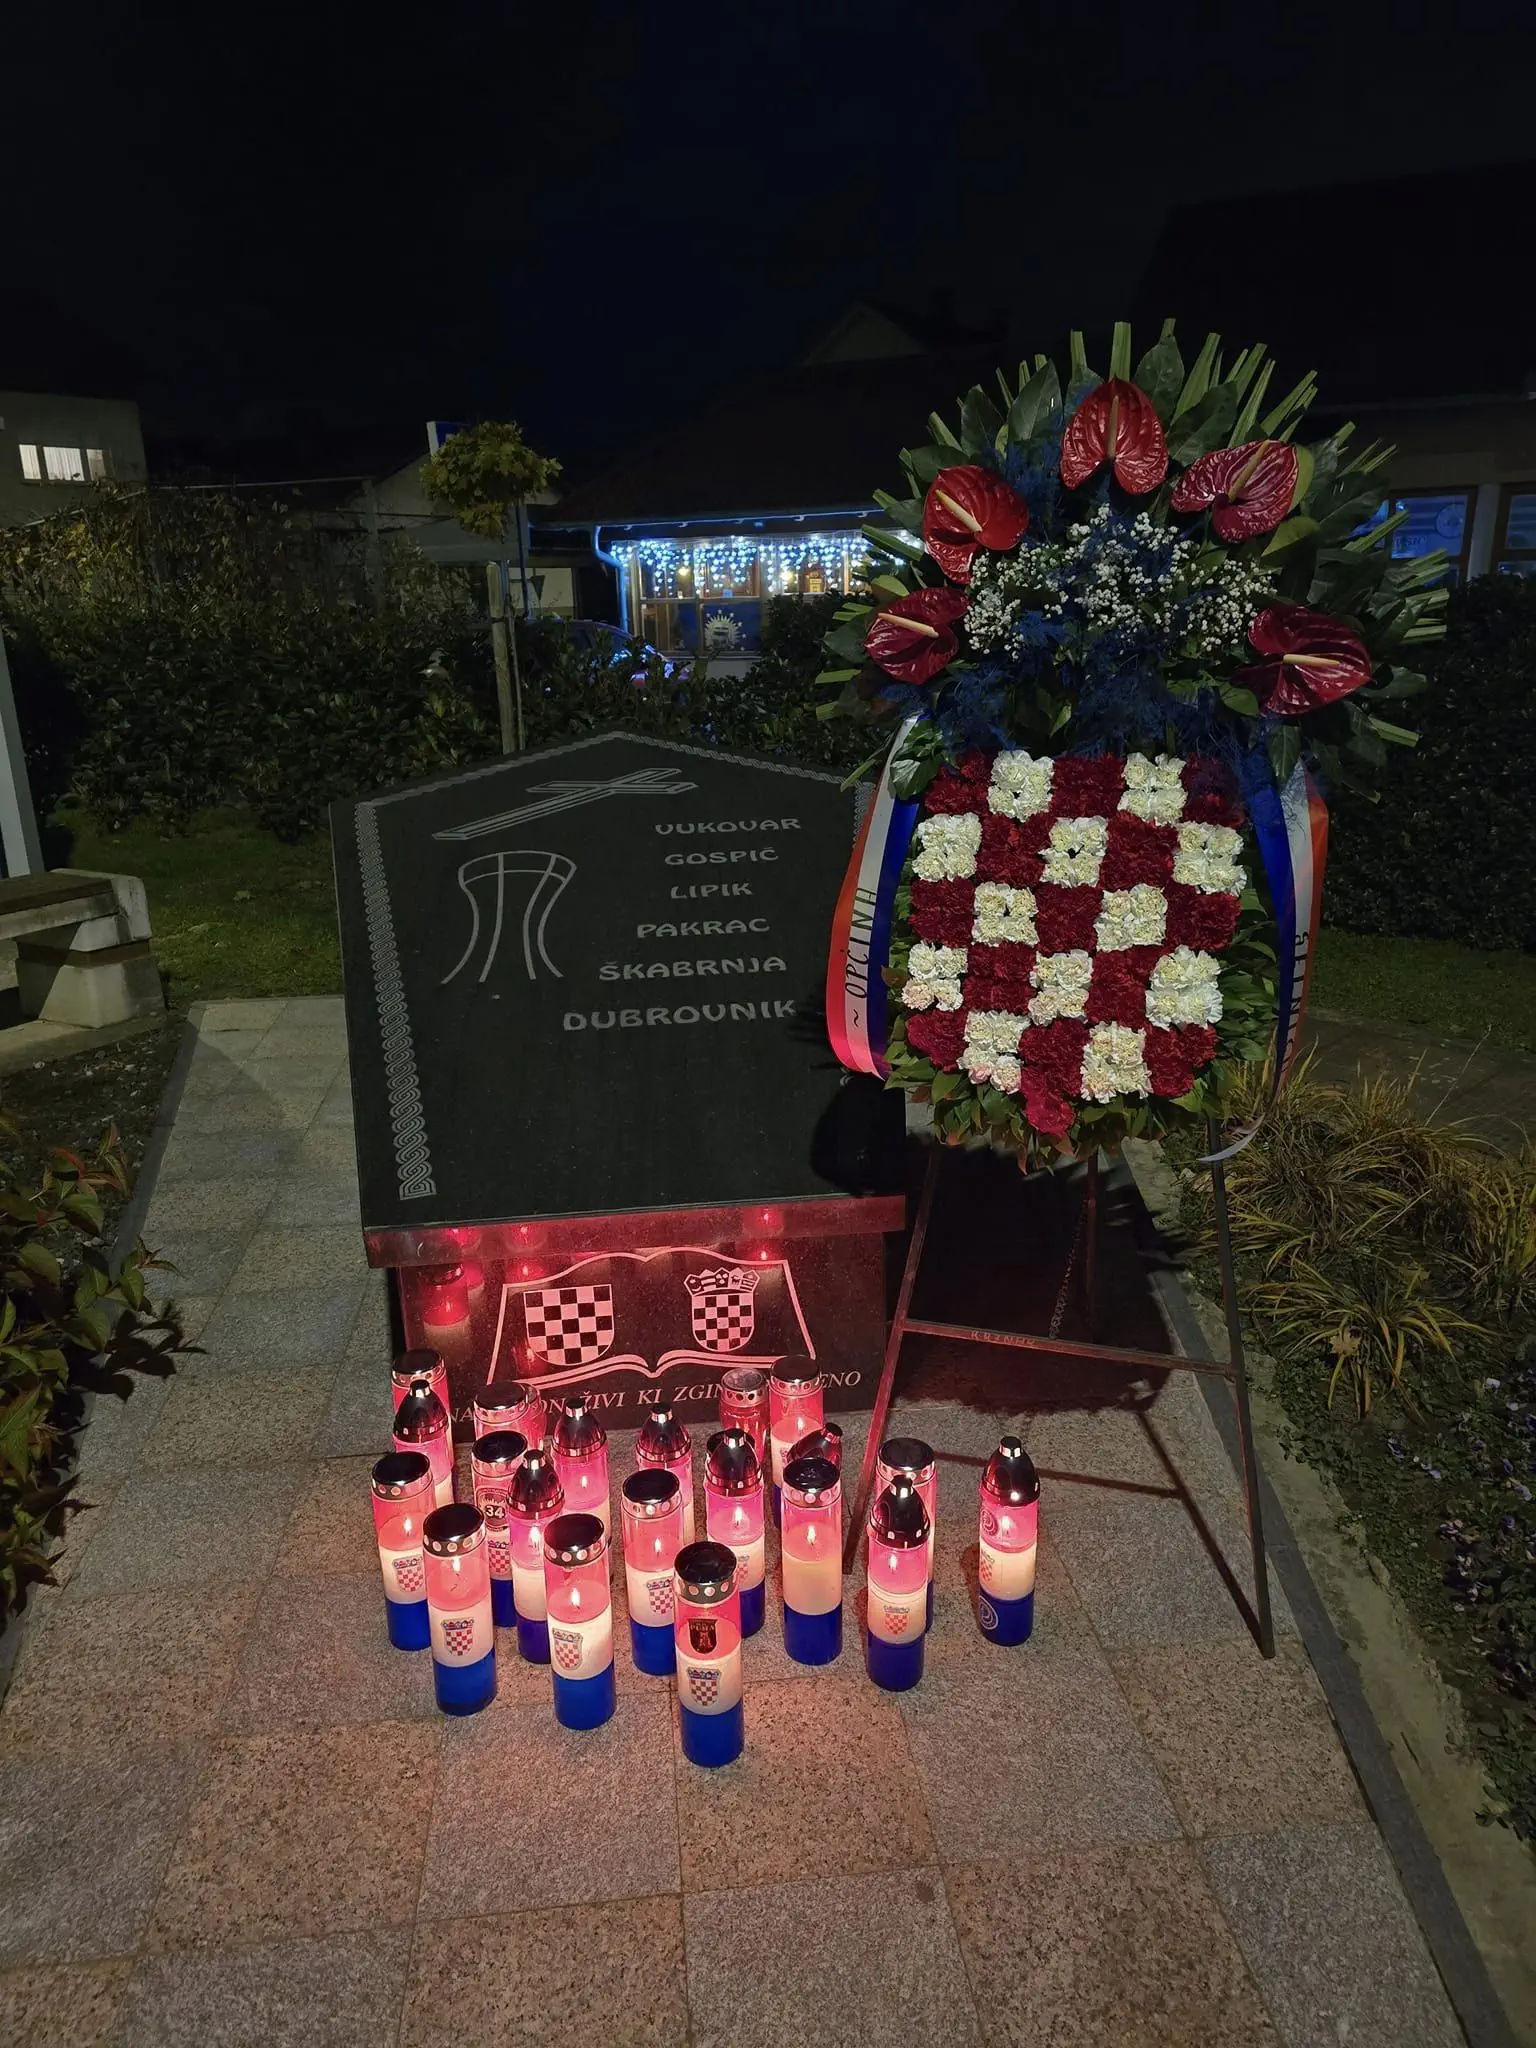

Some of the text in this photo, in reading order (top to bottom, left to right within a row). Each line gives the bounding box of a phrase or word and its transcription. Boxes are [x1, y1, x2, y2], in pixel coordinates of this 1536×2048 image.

[655, 818, 801, 835] VUKOVAR
[671, 882, 753, 899] LIPIK
[636, 918, 770, 938] PAKRAC
[599, 956, 787, 981] ŠKABRNJA
[563, 1000, 796, 1031] DUBROVNIK
[637, 1388, 662, 1406] KI
[486, 1505, 504, 1519] 34
